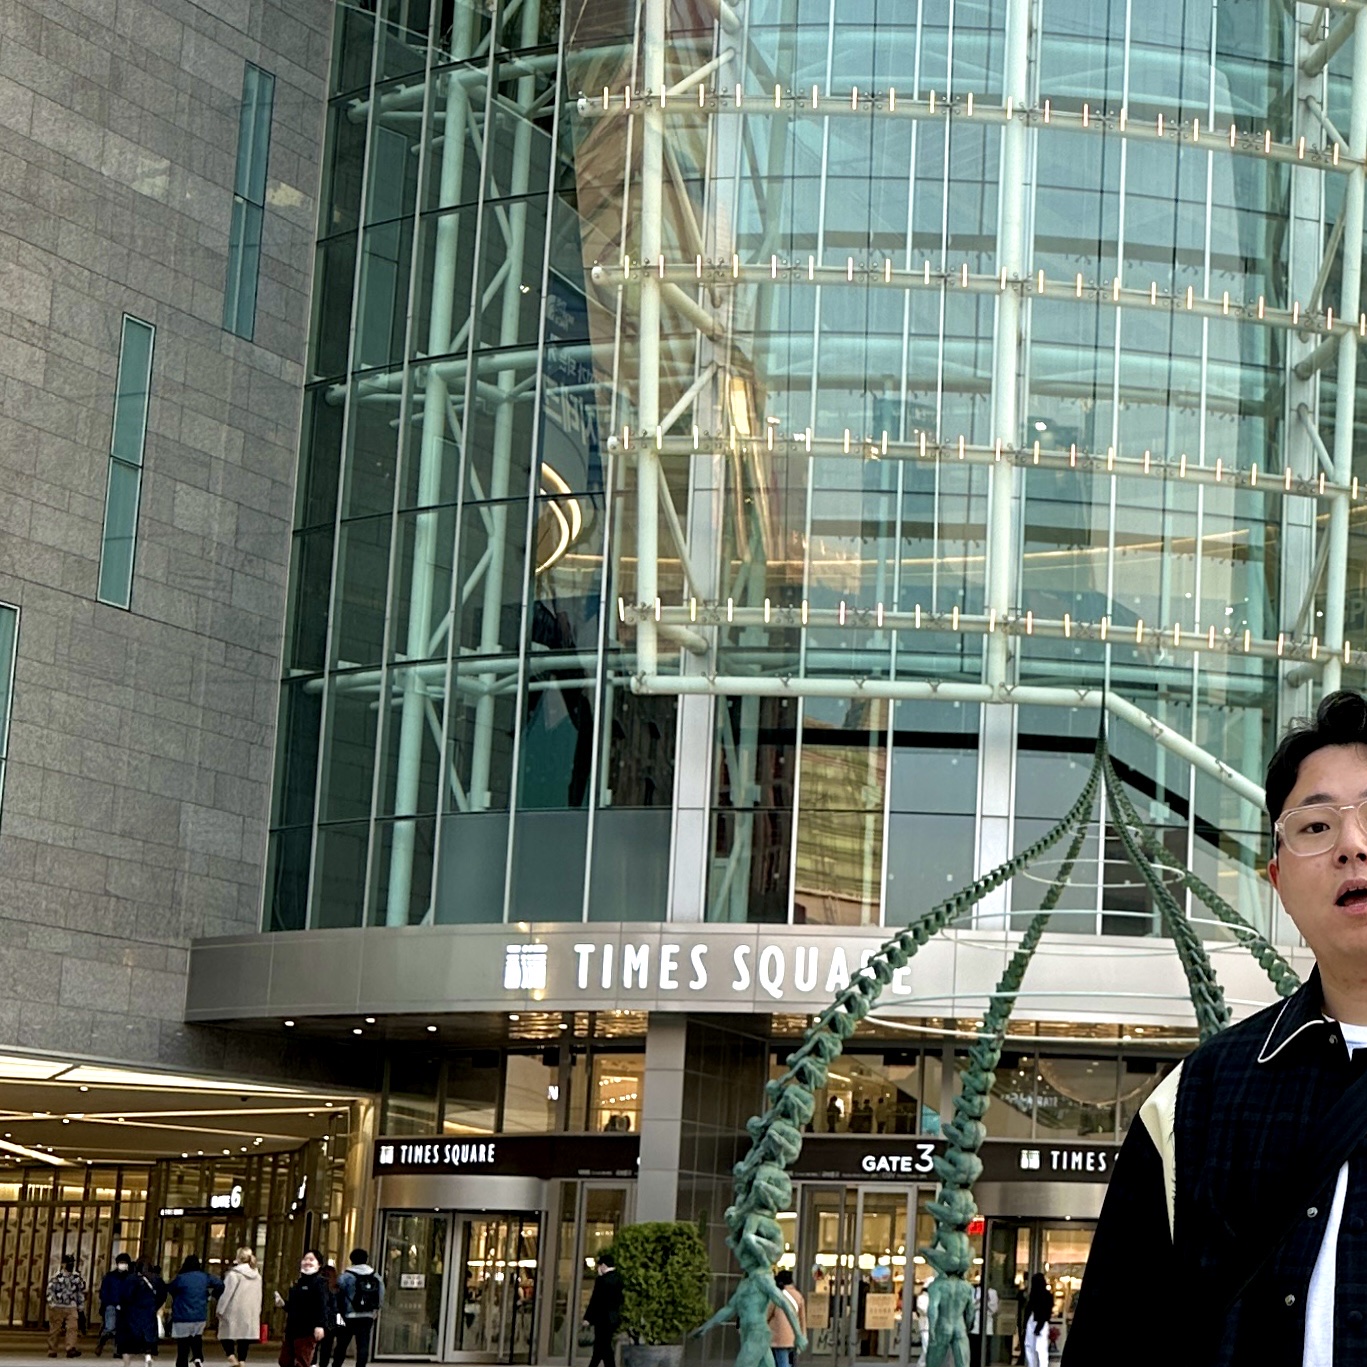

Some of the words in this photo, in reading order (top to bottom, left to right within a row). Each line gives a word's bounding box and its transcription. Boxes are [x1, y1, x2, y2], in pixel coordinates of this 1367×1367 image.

[574, 943, 709, 990] TIMES
[400, 1144, 439, 1164] TIMES
[443, 1143, 495, 1166] SQUARE
[1051, 1151, 1107, 1172] TIMES
